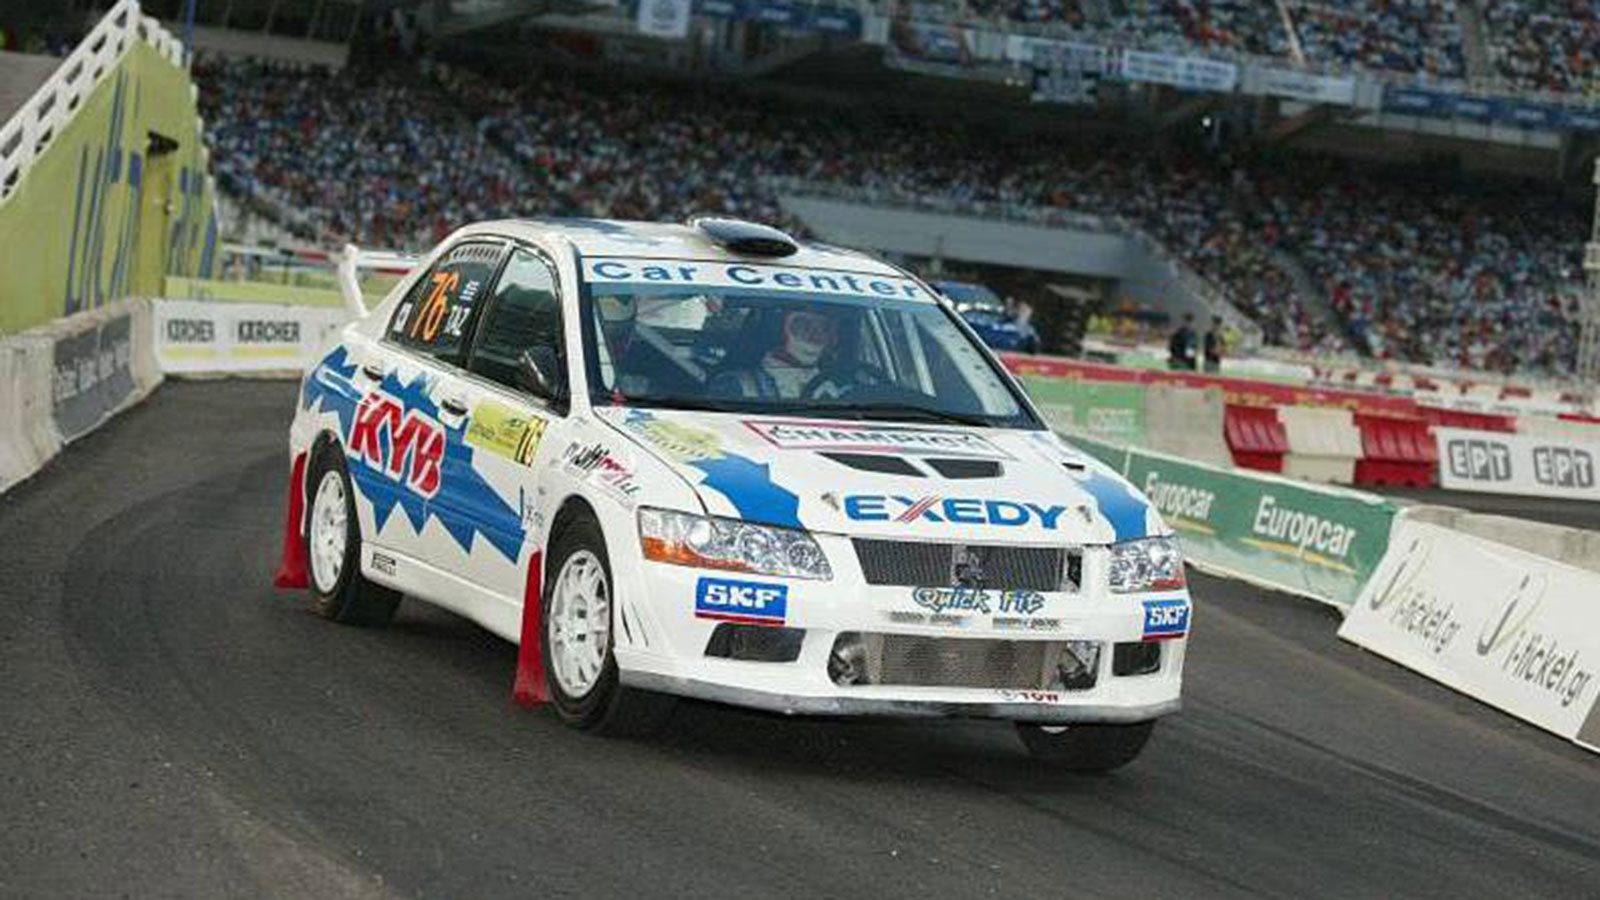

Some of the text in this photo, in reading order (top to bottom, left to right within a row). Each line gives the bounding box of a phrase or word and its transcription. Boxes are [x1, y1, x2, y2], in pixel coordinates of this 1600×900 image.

[593, 261, 920, 299] Car Center
[411, 271, 459, 342] 76
[348, 392, 446, 498] KYB
[843, 491, 1066, 530] EXEDY
[1145, 471, 1216, 523] Europcar
[1253, 495, 1356, 558] Europcar
[704, 584, 781, 609] SKF
[1149, 605, 1188, 626] SKF
